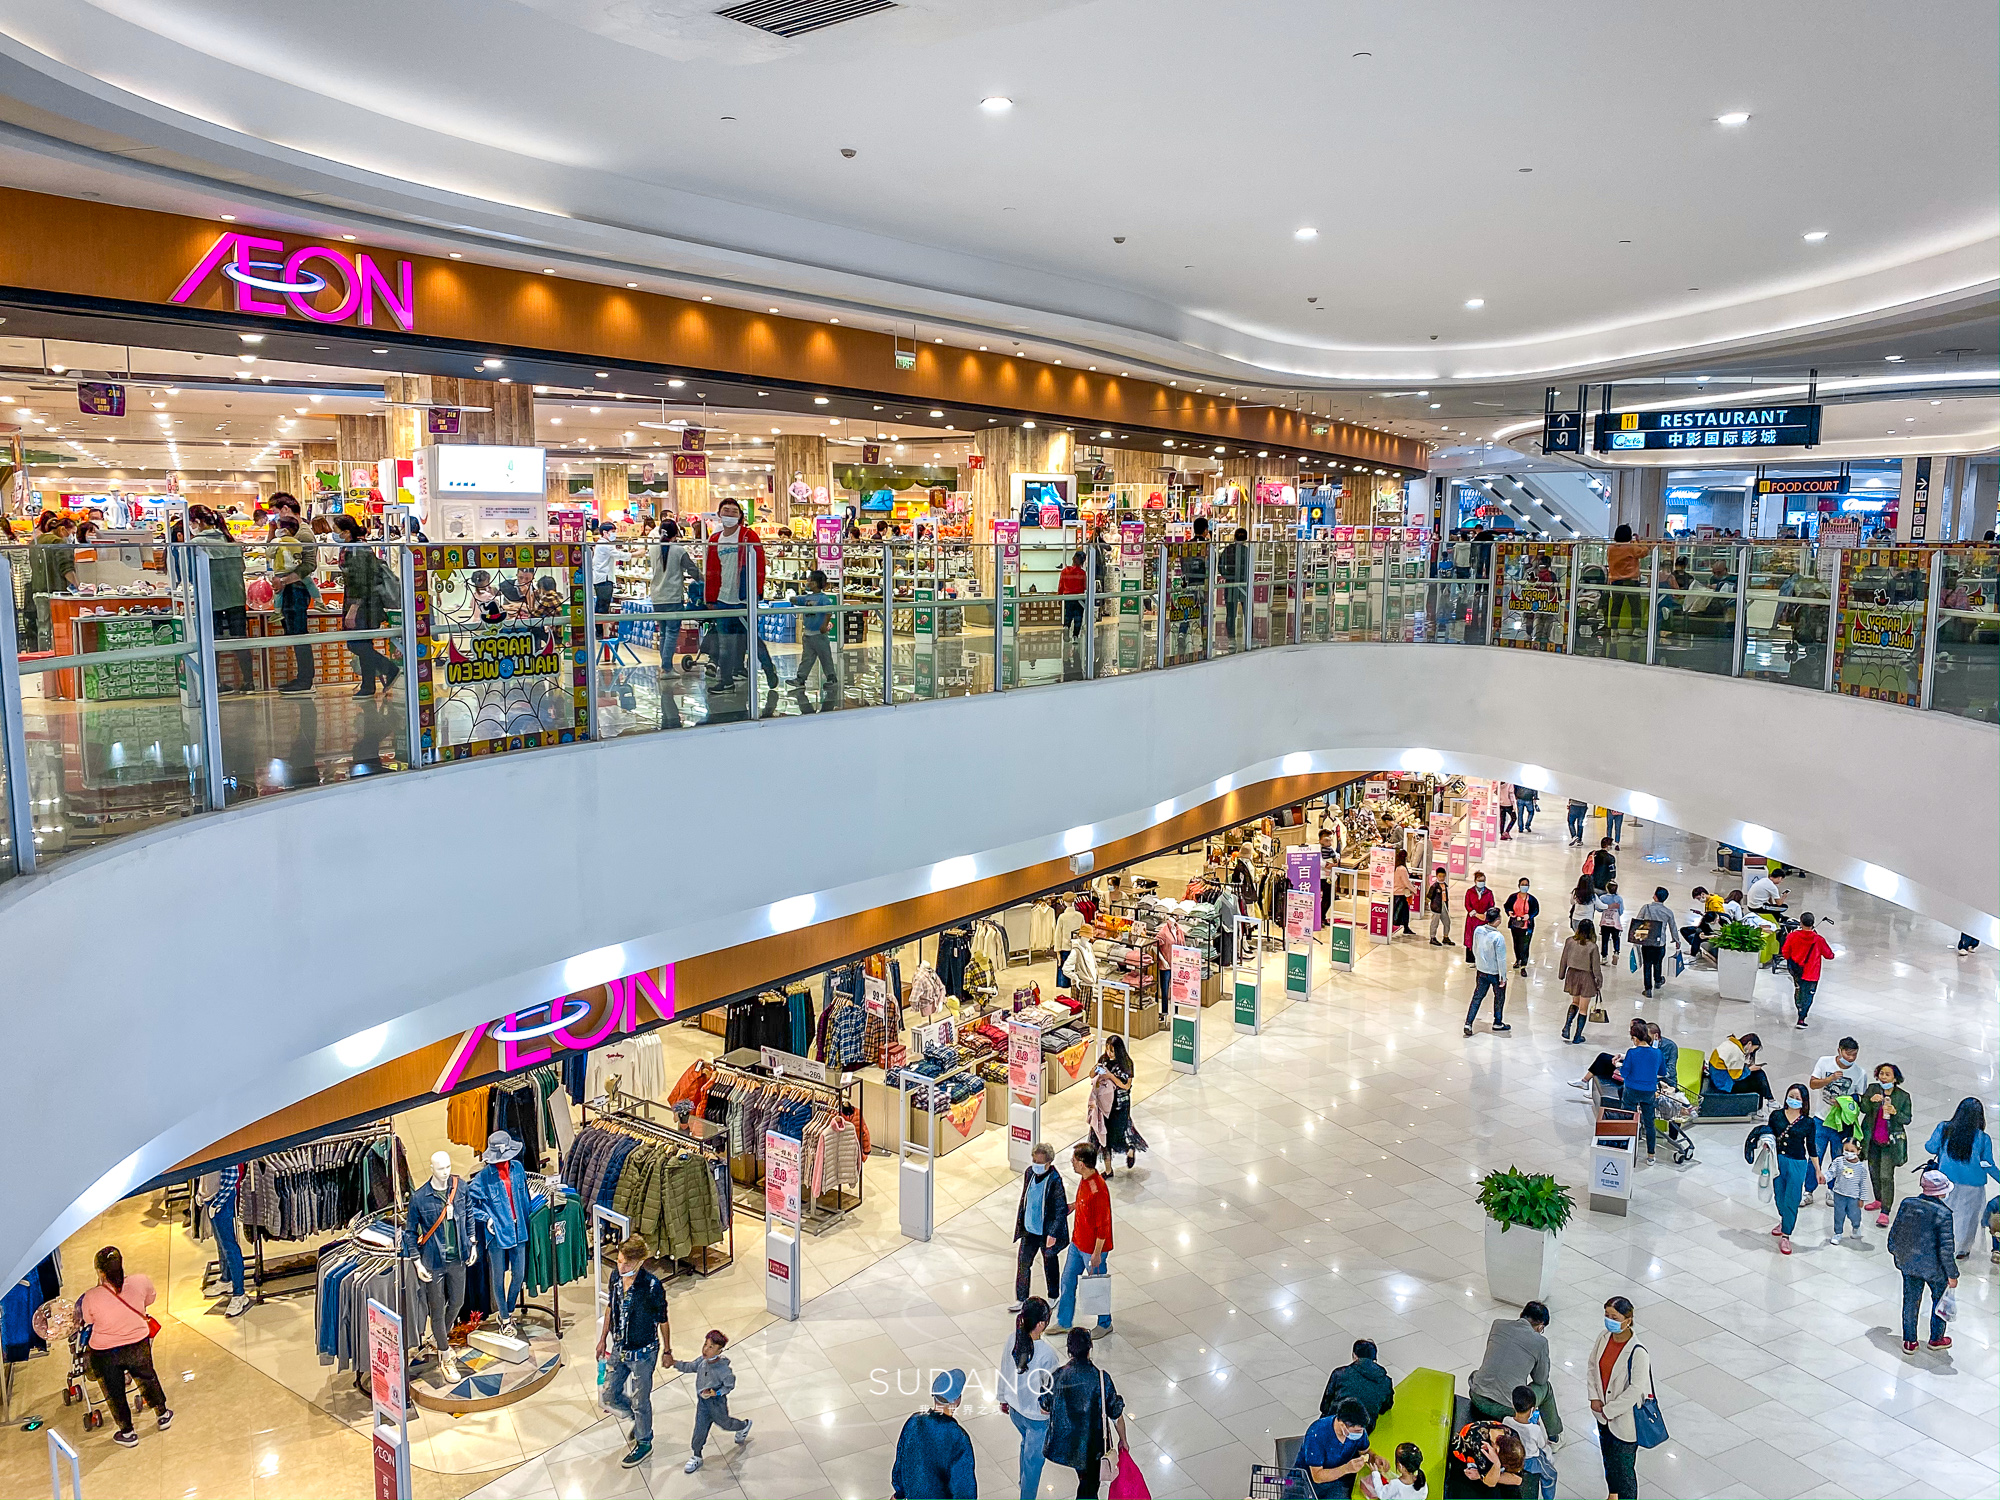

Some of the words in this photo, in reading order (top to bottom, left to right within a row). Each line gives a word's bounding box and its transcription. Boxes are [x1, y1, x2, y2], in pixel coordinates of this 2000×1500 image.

[1660, 410, 1788, 427] RESTAURANT
[1668, 429, 1777, 447] 中影国际影城
[1771, 482, 1801, 493] FOOD
[1803, 481, 1839, 492] COURT
